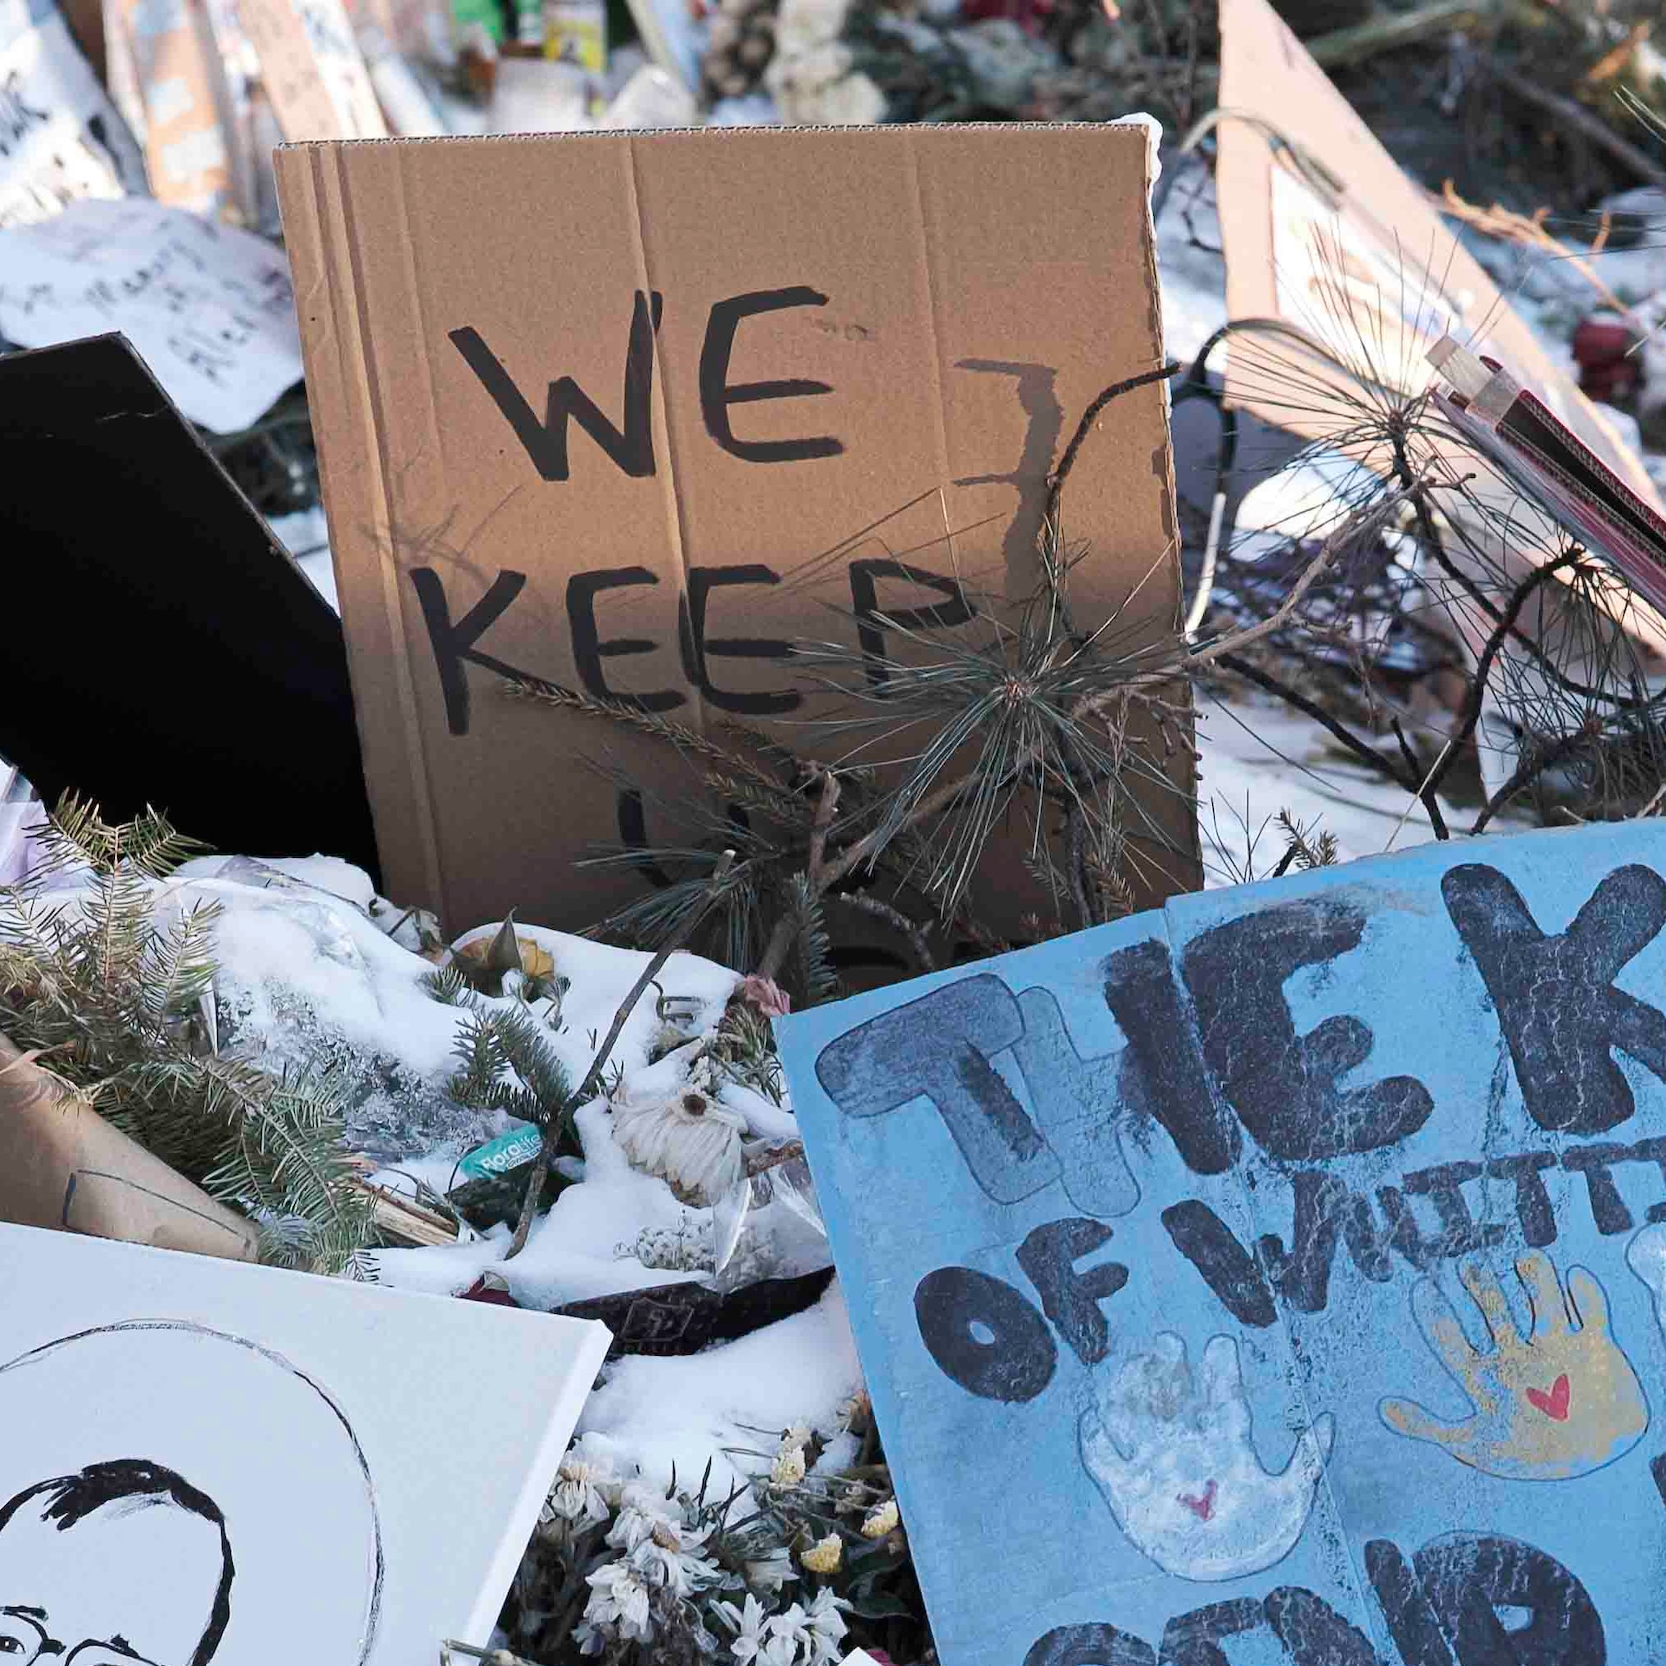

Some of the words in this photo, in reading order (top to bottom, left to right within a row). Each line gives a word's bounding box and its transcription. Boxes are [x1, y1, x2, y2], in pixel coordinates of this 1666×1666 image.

[447, 284, 844, 483] WE
[409, 556, 979, 737] KEEP
[813, 888, 1437, 1226] THE
[913, 1216, 1131, 1403] OF
